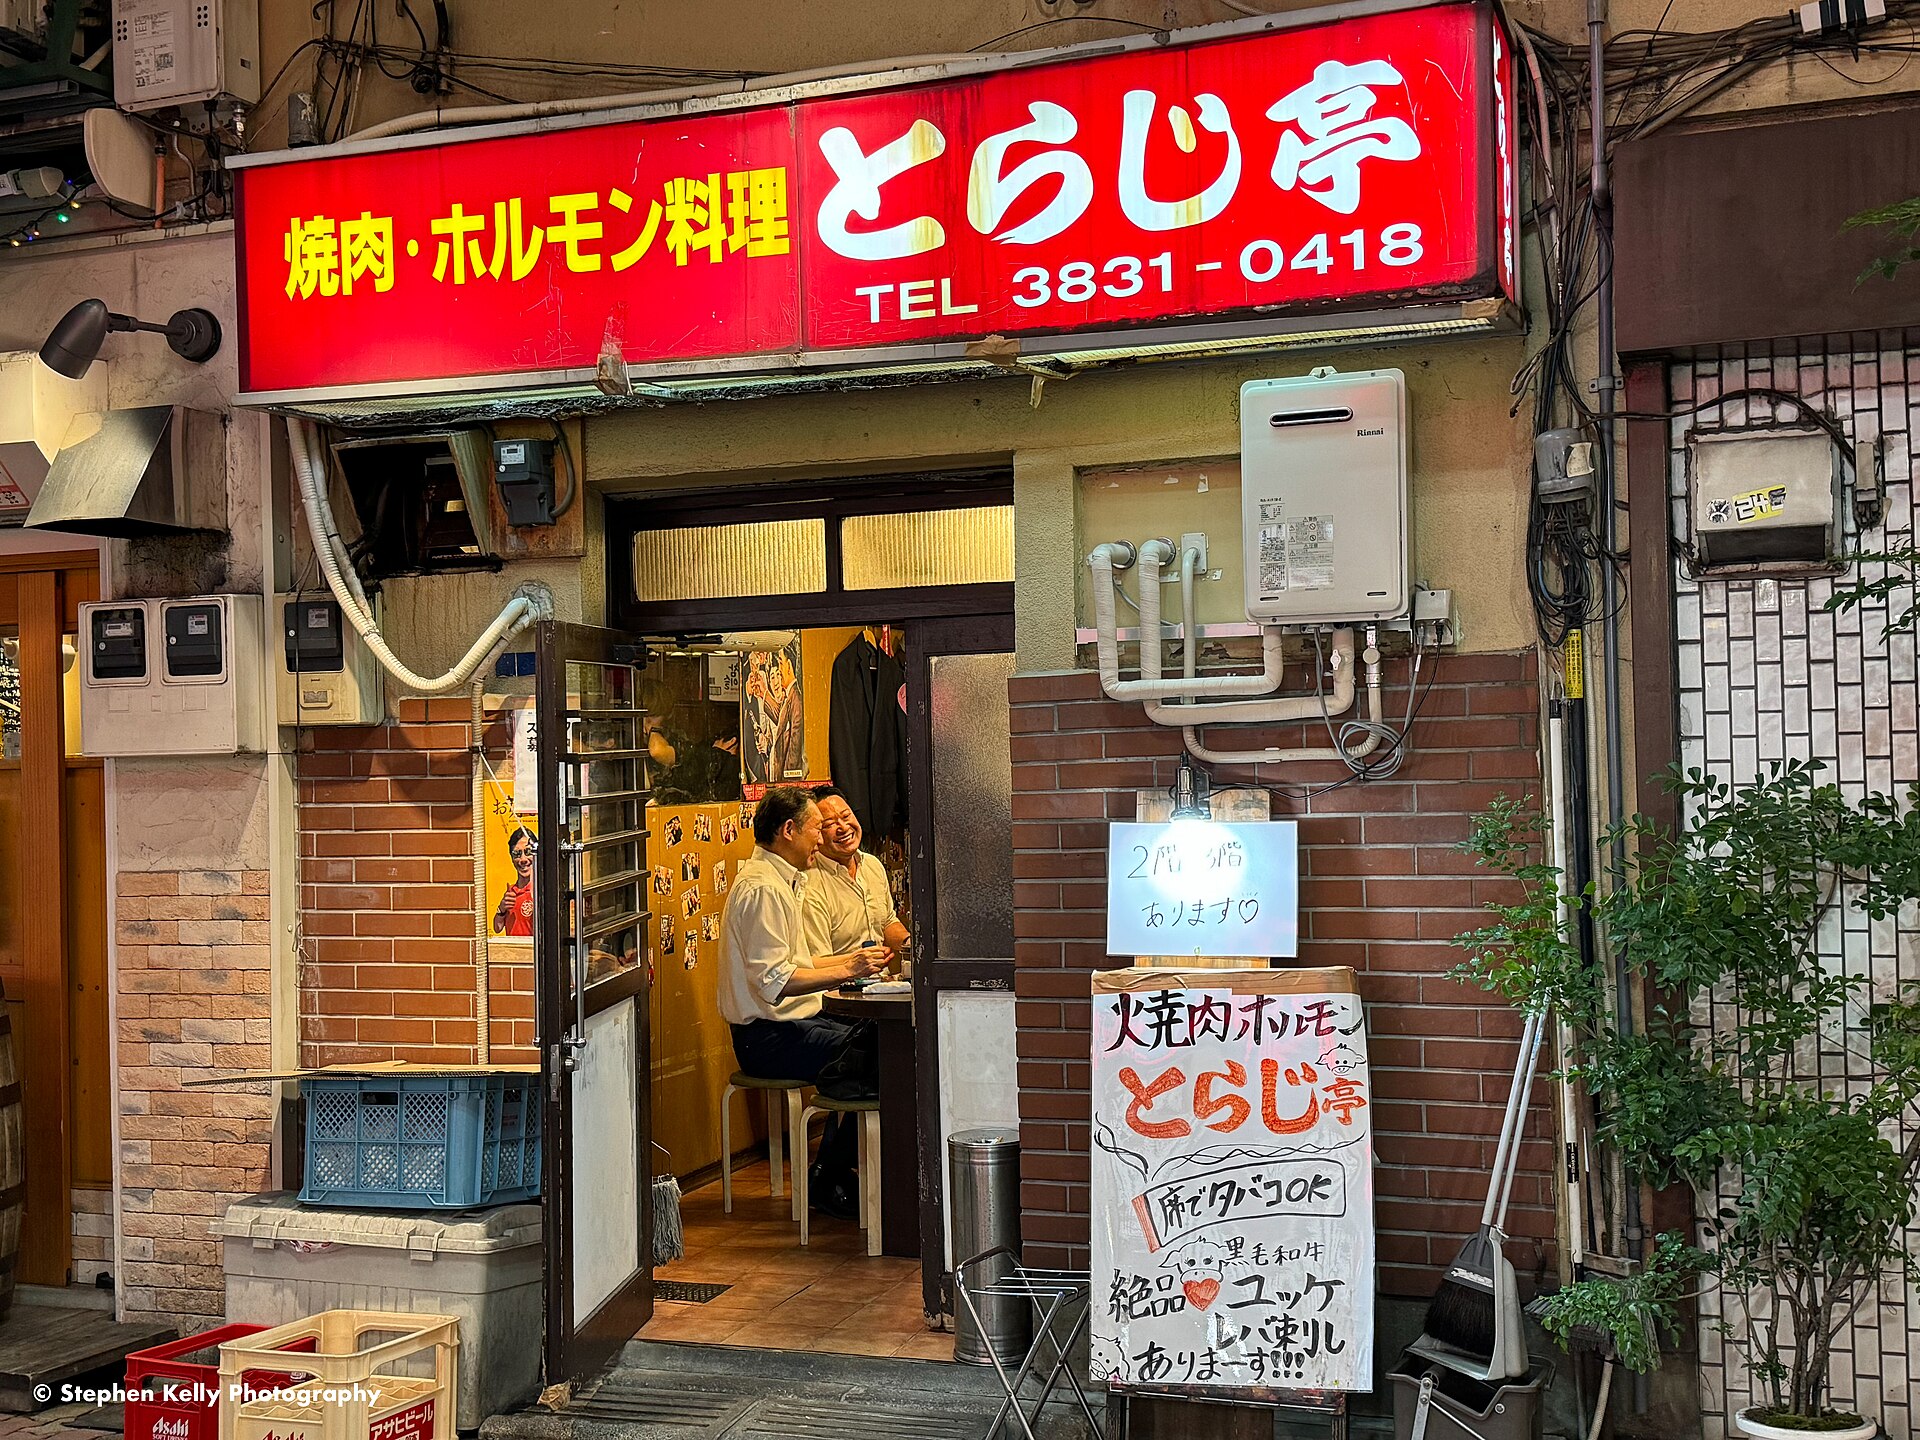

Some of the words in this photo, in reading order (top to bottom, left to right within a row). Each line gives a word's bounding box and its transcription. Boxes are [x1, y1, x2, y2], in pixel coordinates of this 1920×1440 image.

[817, 60, 1421, 260] とらじ亭
[856, 278, 978, 323] TEL
[1357, 428, 1383, 436] Rinnai
[1105, 990, 1363, 1052] 焼肉ホルモン
[1118, 1058, 1367, 1139] とらじ亭
[1158, 1174, 1332, 1238] 席でタバコOK
[1224, 1236, 1325, 1267] 黒毛和牛
[1107, 1268, 1187, 1323] 絶品
[1226, 1273, 1346, 1312] ユッケ
[152, 1416, 189, 1437] Asahi
[371, 1404, 434, 1440] アサヒビール
